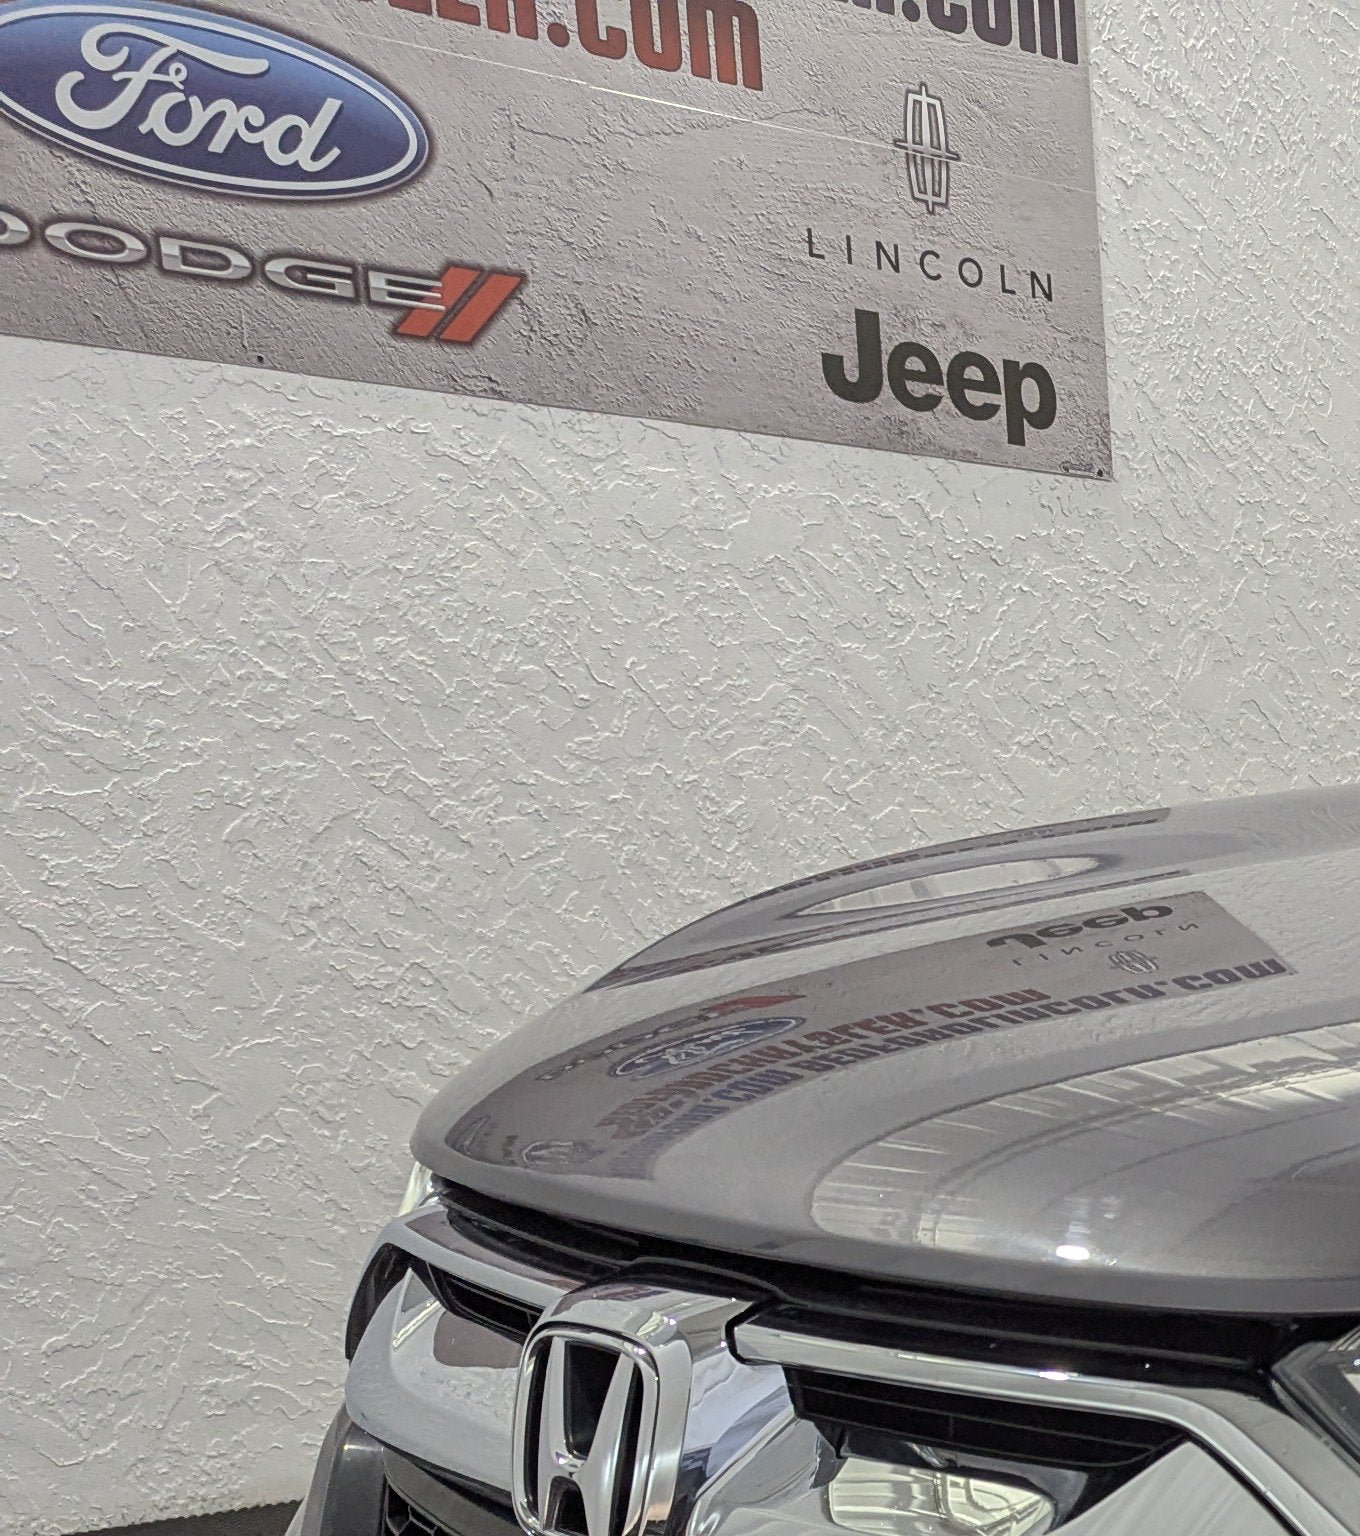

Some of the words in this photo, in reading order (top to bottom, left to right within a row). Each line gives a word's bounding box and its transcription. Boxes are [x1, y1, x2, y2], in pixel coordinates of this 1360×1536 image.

[388, 0, 765, 92] .COM
[838, 0, 1079, 65] .OM
[55, 23, 343, 173] Ford
[806, 227, 1053, 303] LINCOLN
[821, 308, 1058, 447] Jeep
